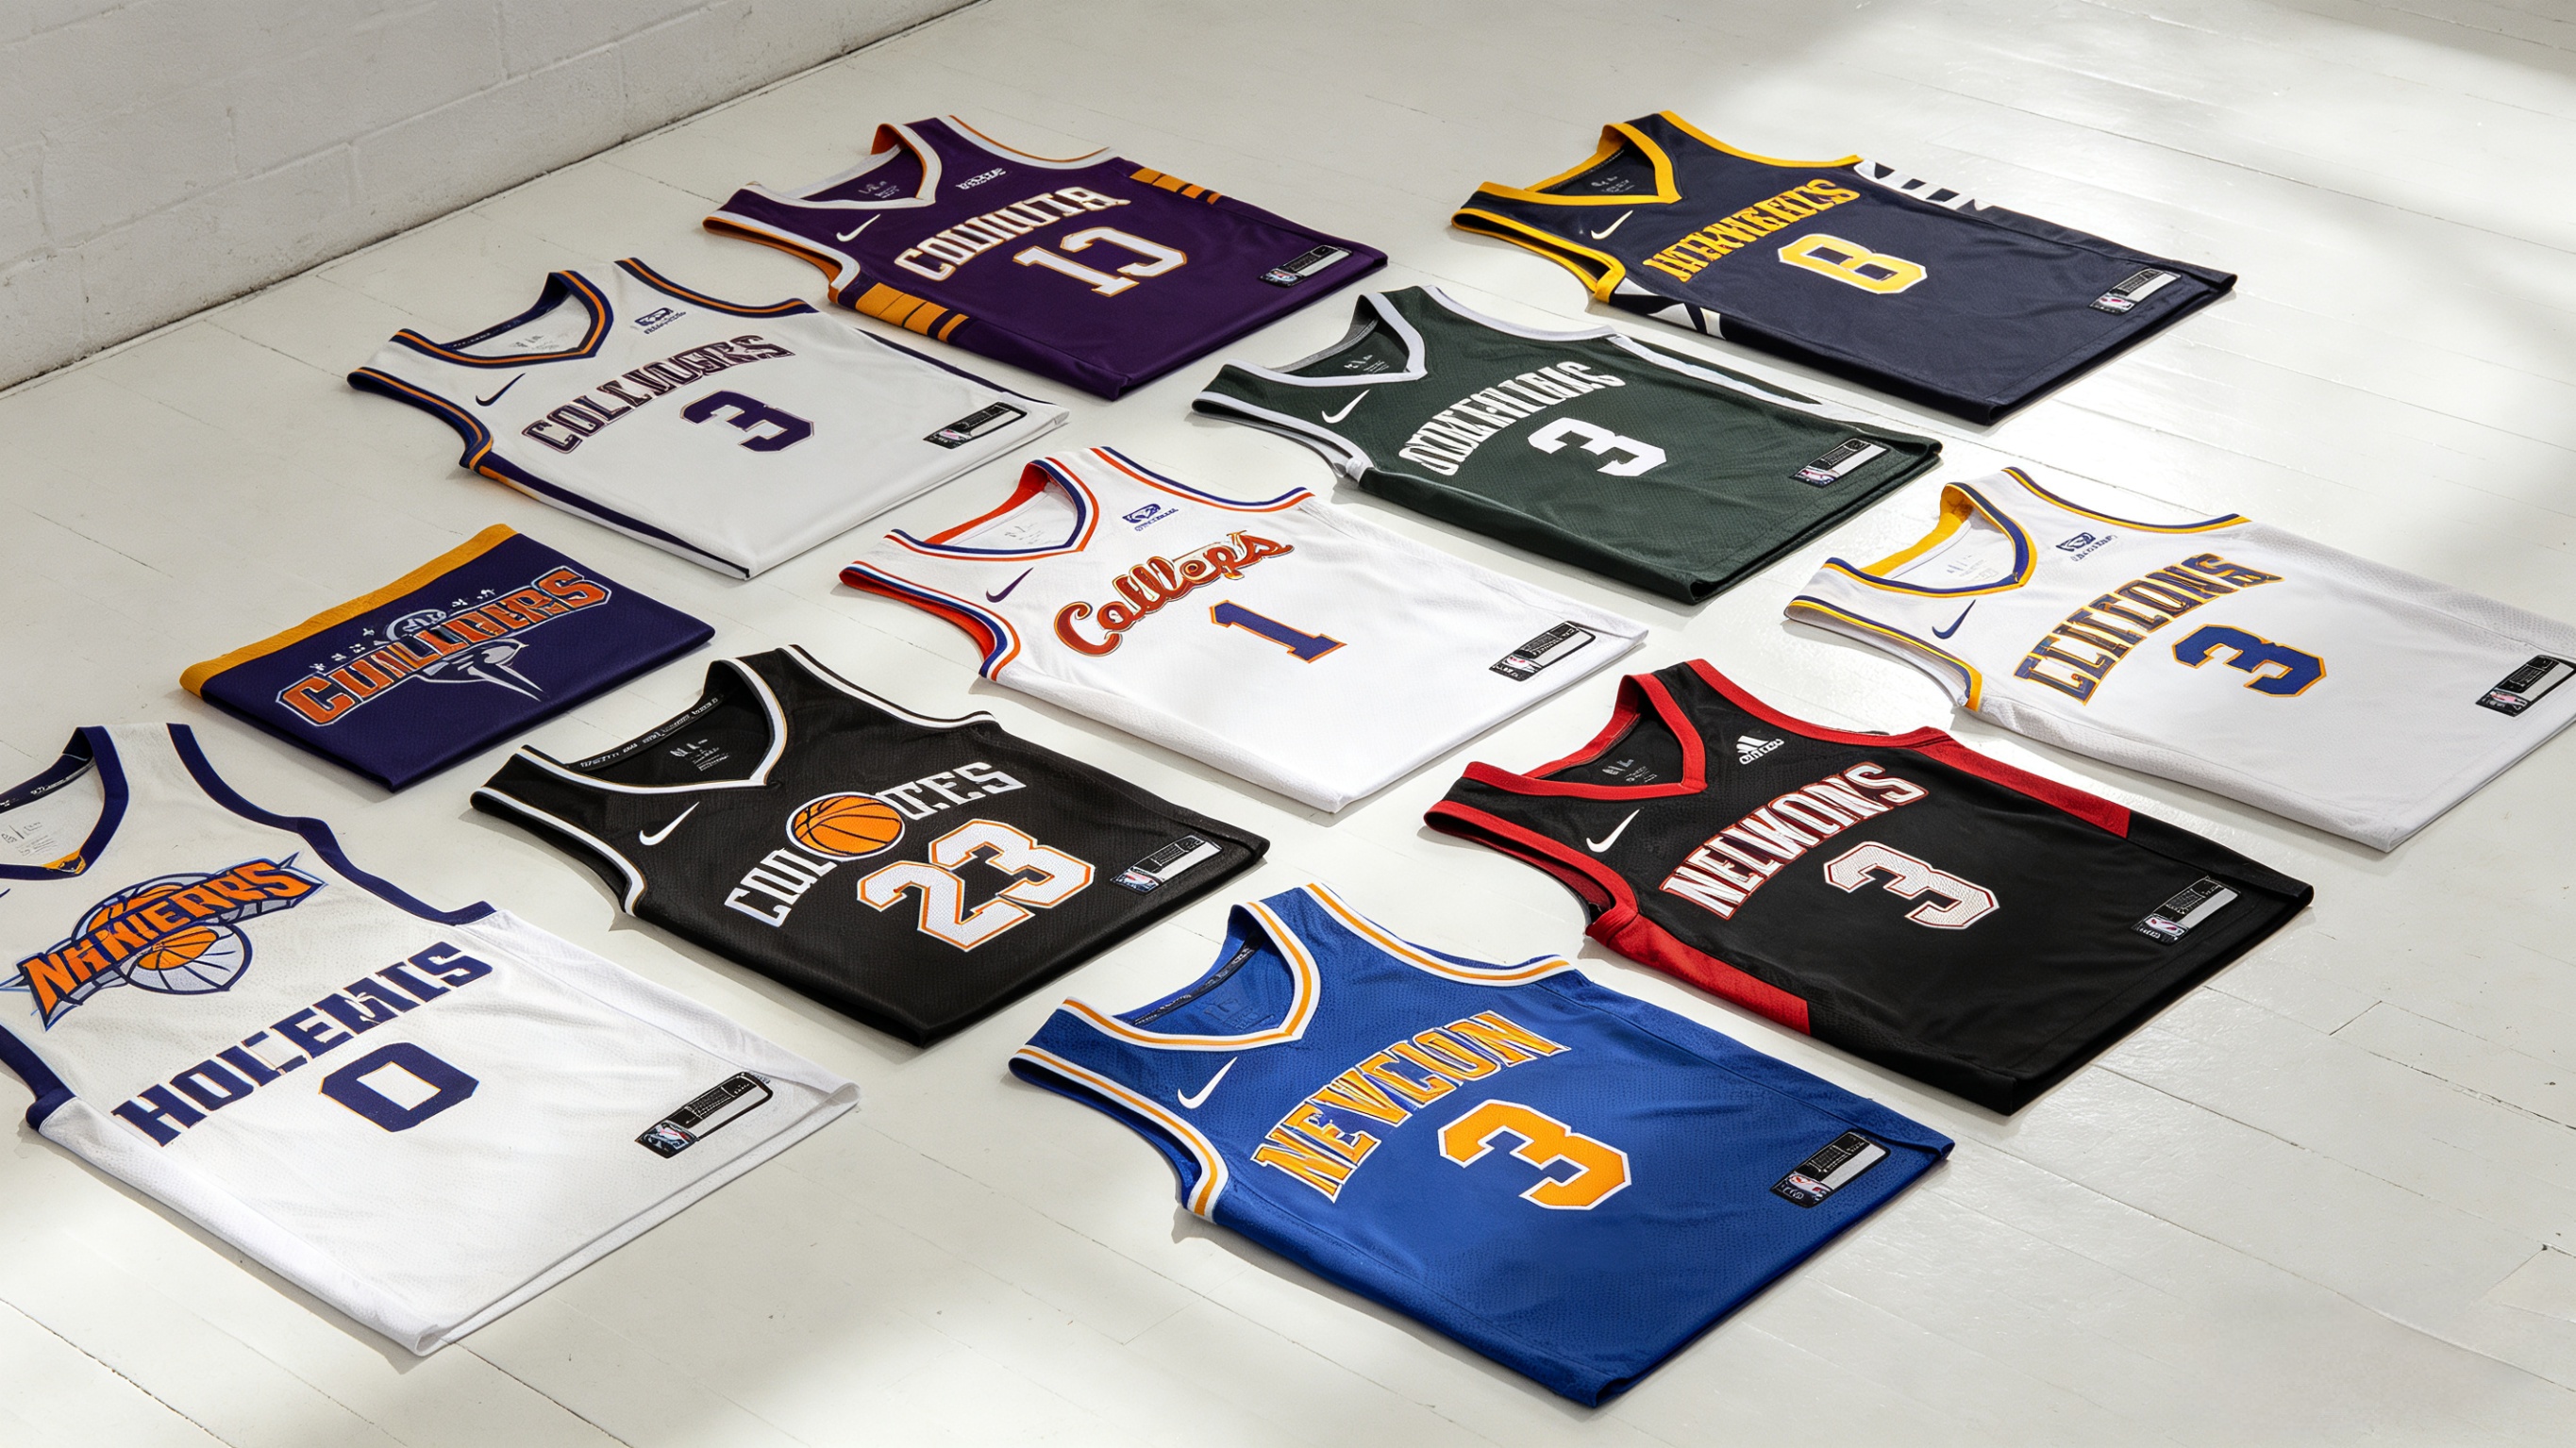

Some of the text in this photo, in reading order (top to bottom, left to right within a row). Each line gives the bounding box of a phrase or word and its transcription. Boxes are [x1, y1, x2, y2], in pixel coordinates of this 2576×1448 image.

[1778, 233, 1928, 294] 8
[679, 389, 815, 452] 3
[1528, 417, 1664, 477] 3
[1209, 599, 1348, 664] 1
[2171, 624, 2328, 698] 3
[856, 818, 1096, 952] 23
[1822, 841, 2000, 930] 3
[318, 1041, 480, 1133] 0
[1437, 1098, 1632, 1211] 3
